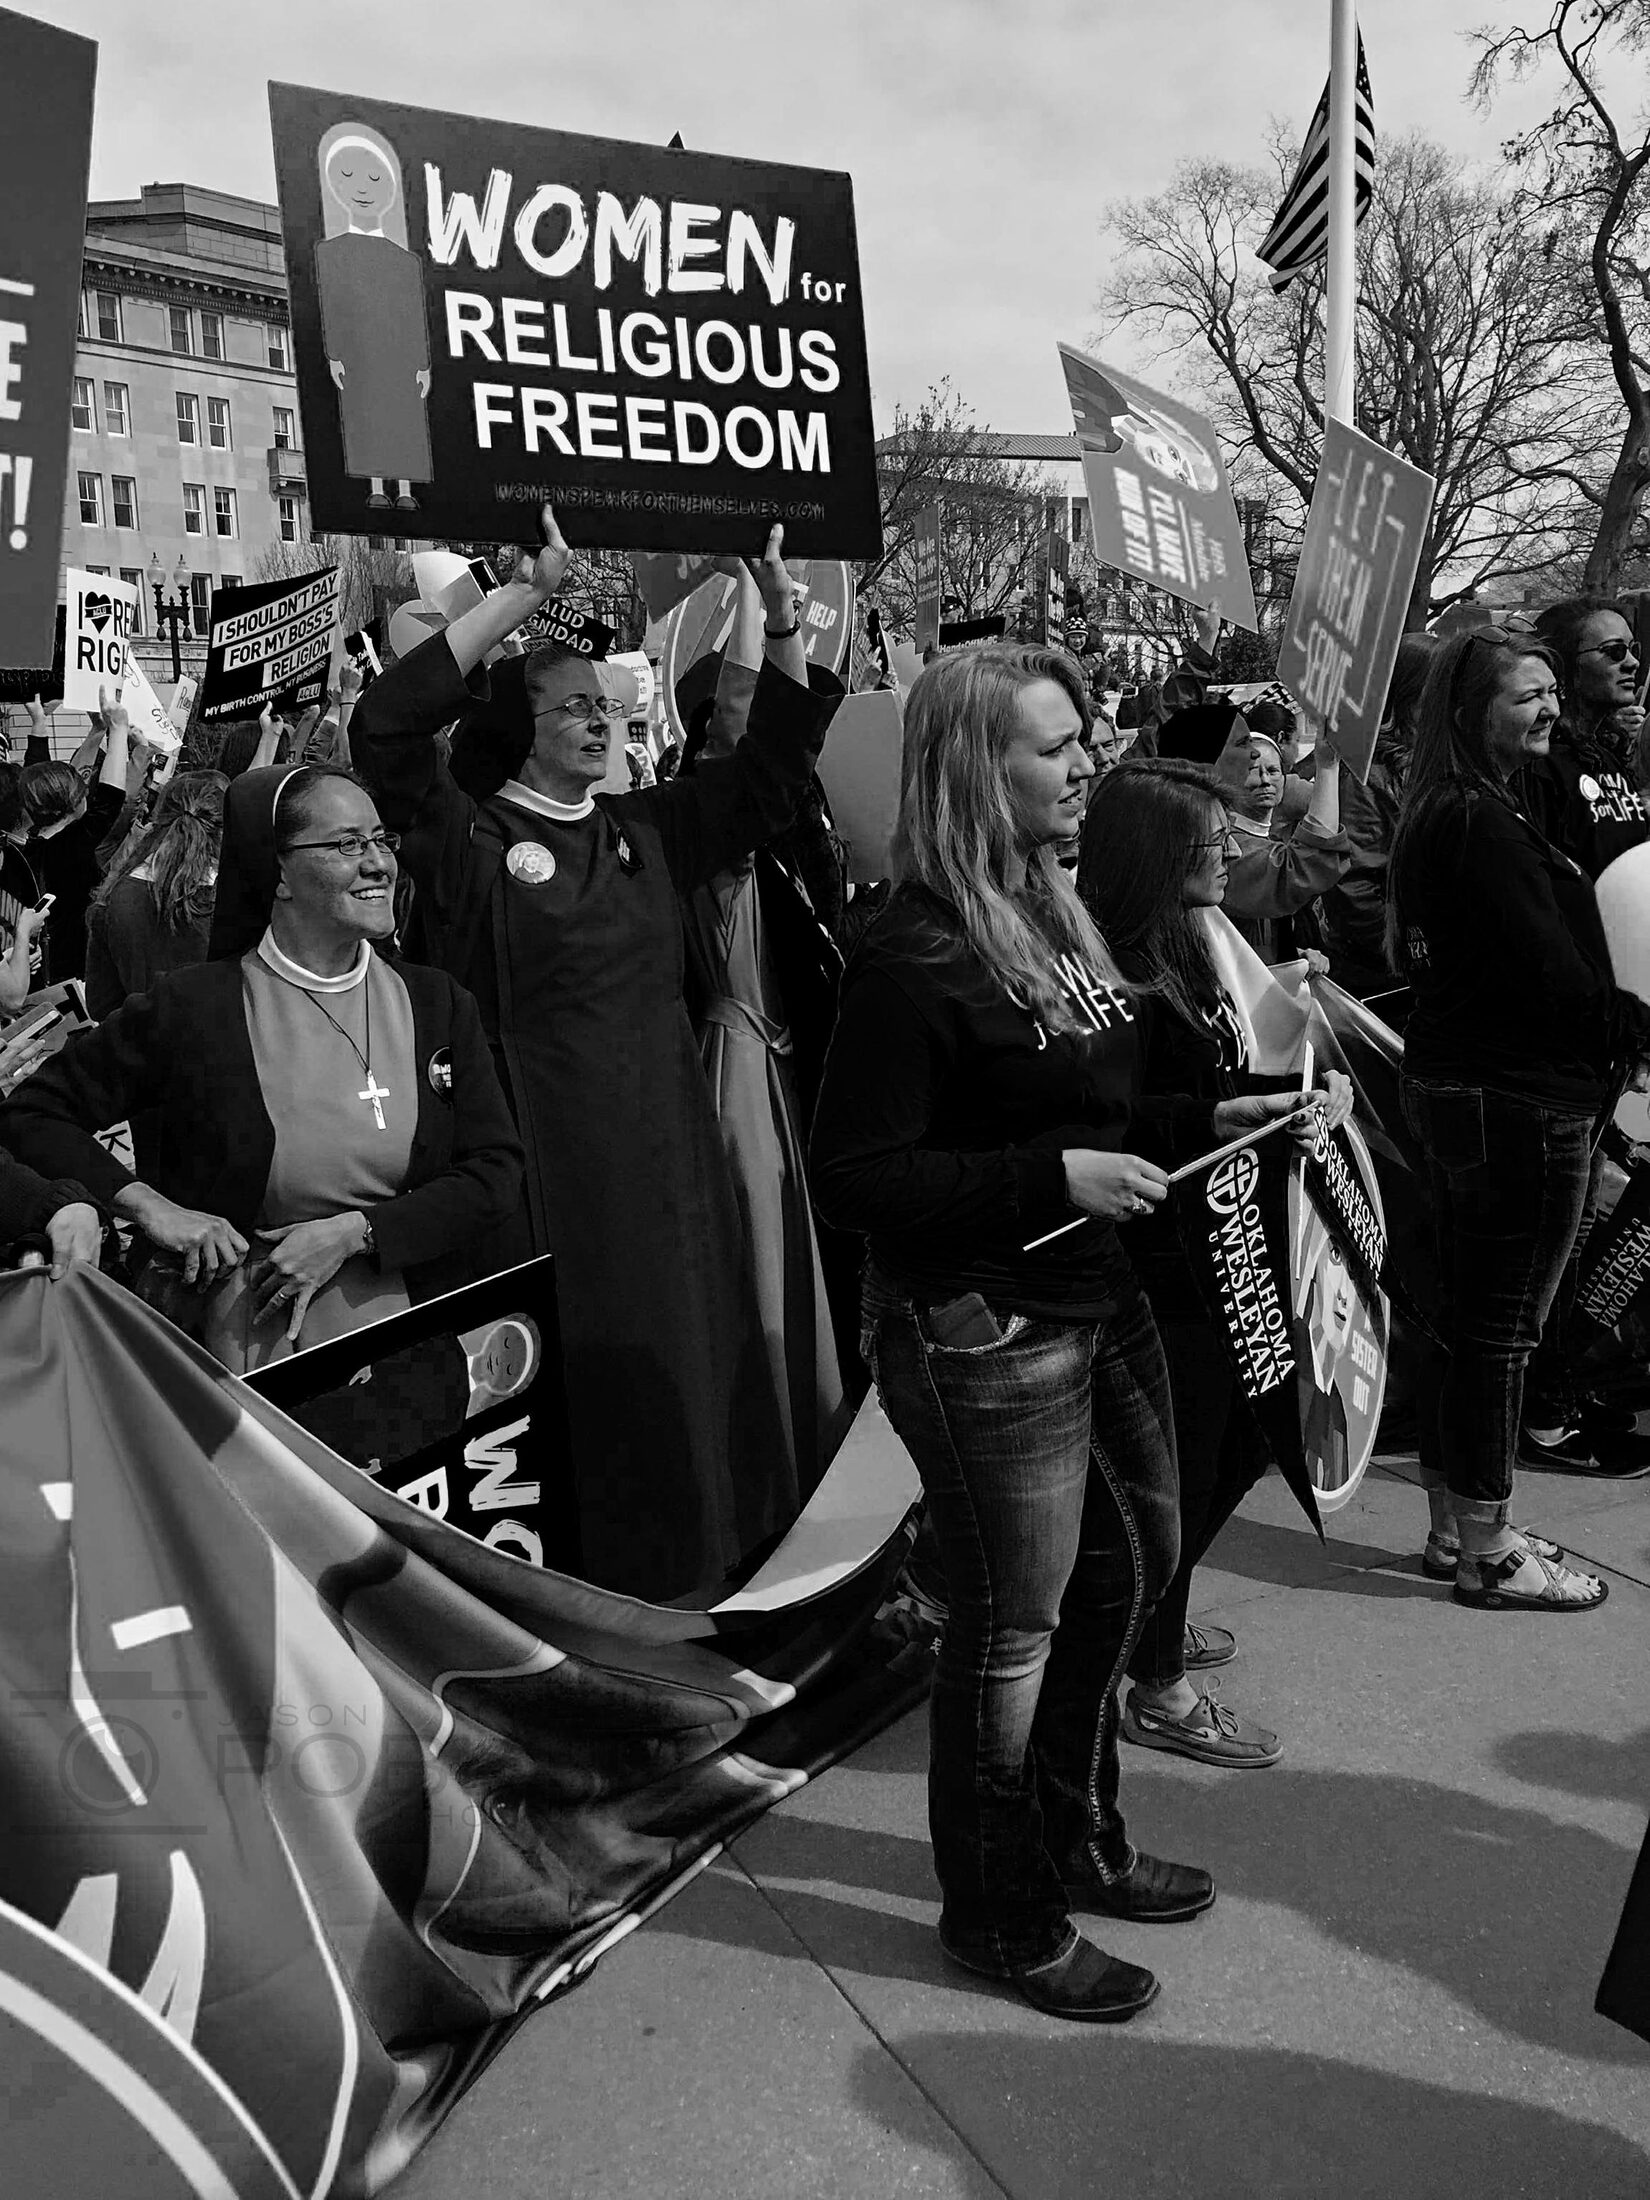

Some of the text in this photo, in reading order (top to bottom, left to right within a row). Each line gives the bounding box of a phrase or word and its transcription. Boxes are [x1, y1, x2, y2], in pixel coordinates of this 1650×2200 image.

[424, 162, 846, 305] WOMEN for
[445, 290, 840, 392] RELIGIOUS
[473, 382, 831, 472] FREEDOM
[225, 589, 310, 640] SHOULDN'T
[311, 573, 337, 604] PAY
[229, 603, 333, 667] FOR MY BOSS'S
[806, 600, 837, 630] HELP
[271, 633, 330, 682] RELIGION
[220, 697, 246, 713] BIRTH
[1327, 1154, 1384, 1273] WESLEYAN
[1329, 1140, 1384, 1255] OKLAHOMA
[1221, 1211, 1280, 1394] WESLEYAN
[1242, 1204, 1296, 1381] OKLAHOMA
[1577, 1217, 1641, 1306] UNIVERSITY
[1208, 1231, 1258, 1399] UNIVERSITY
[1351, 1330, 1378, 1380] SISTER
[1353, 1375, 1370, 1415] OUT
